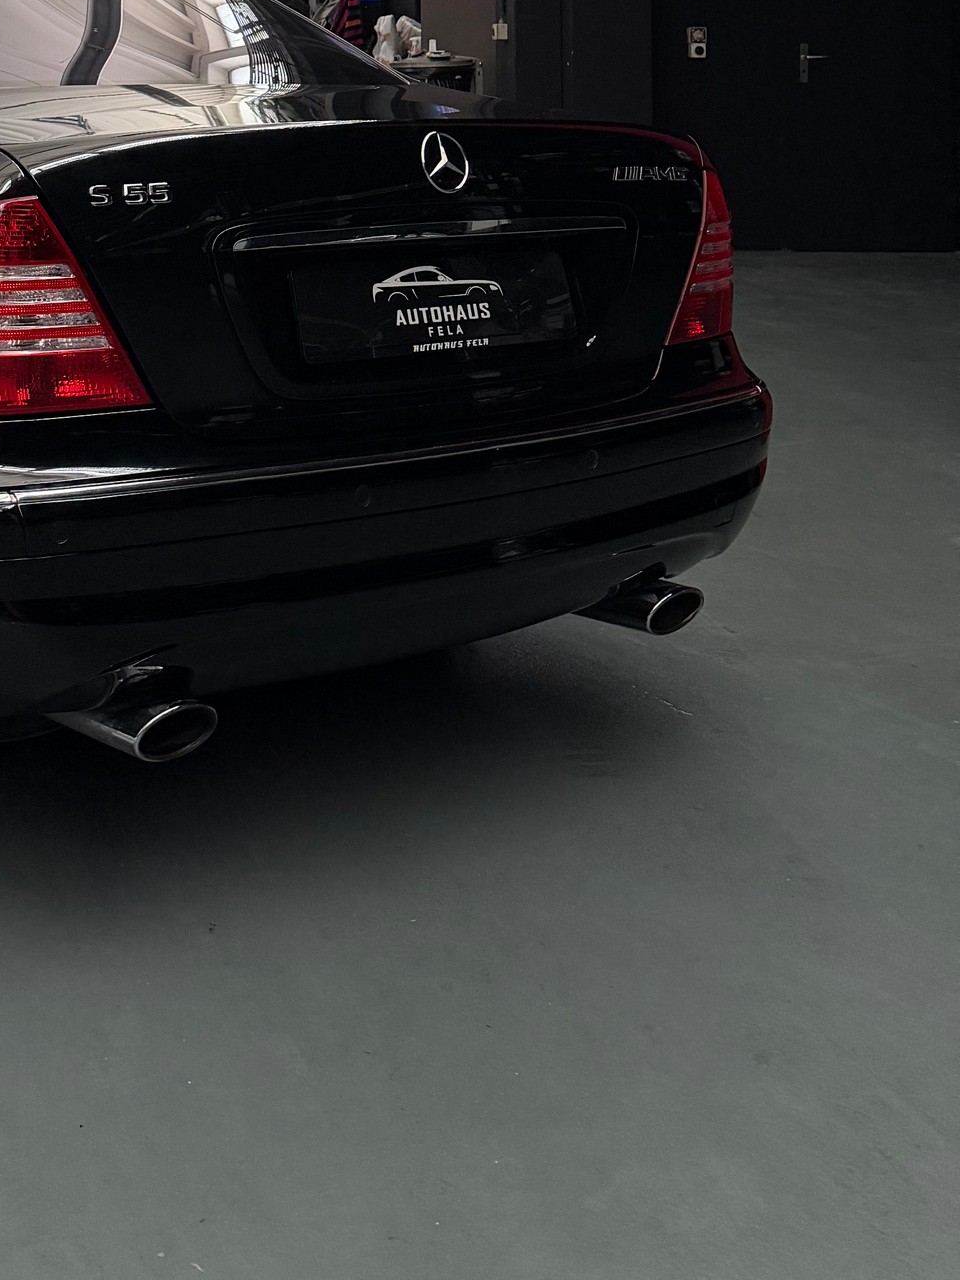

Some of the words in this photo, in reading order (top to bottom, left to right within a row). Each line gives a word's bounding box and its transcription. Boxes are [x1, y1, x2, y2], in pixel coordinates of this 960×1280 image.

[88, 184, 113, 207] S
[122, 181, 173, 206] 55
[396, 302, 491, 326] AUTOHAUS
[427, 324, 464, 338] FELA
